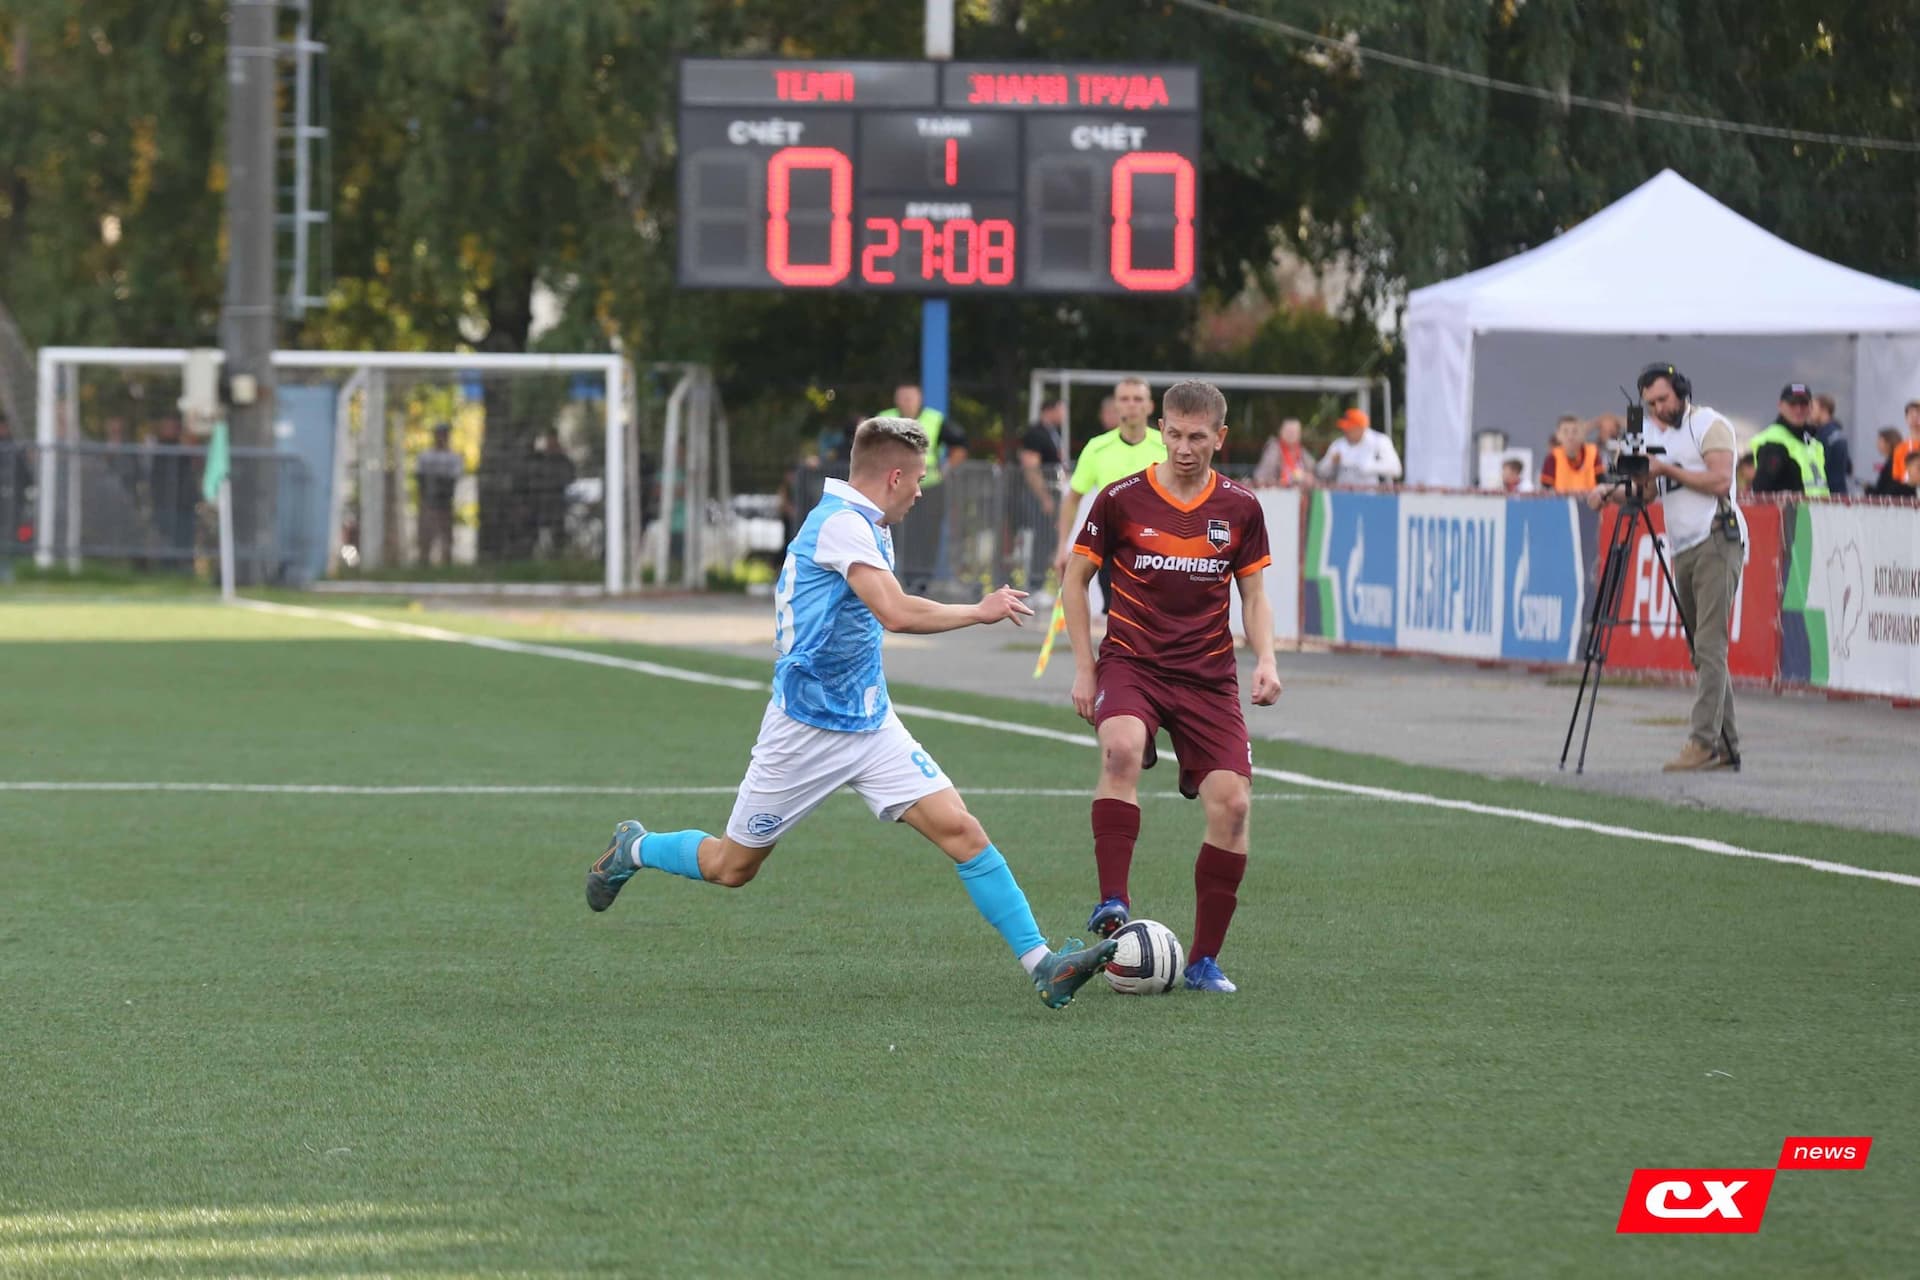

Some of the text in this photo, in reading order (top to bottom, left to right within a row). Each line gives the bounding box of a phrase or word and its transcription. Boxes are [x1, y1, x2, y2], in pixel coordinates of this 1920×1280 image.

[728, 118, 804, 145] СЧЁТ
[1071, 125, 1147, 150] СЧЁТ
[945, 138, 958, 186] 1
[767, 147, 852, 286] 0
[1111, 152, 1195, 291] 0
[862, 218, 1015, 285] 27:08
[1134, 554, 1230, 573] ПРОДИНВЕСТ
[1405, 515, 1495, 634] ГАЗПРОМ
[911, 751, 937, 778] 8
